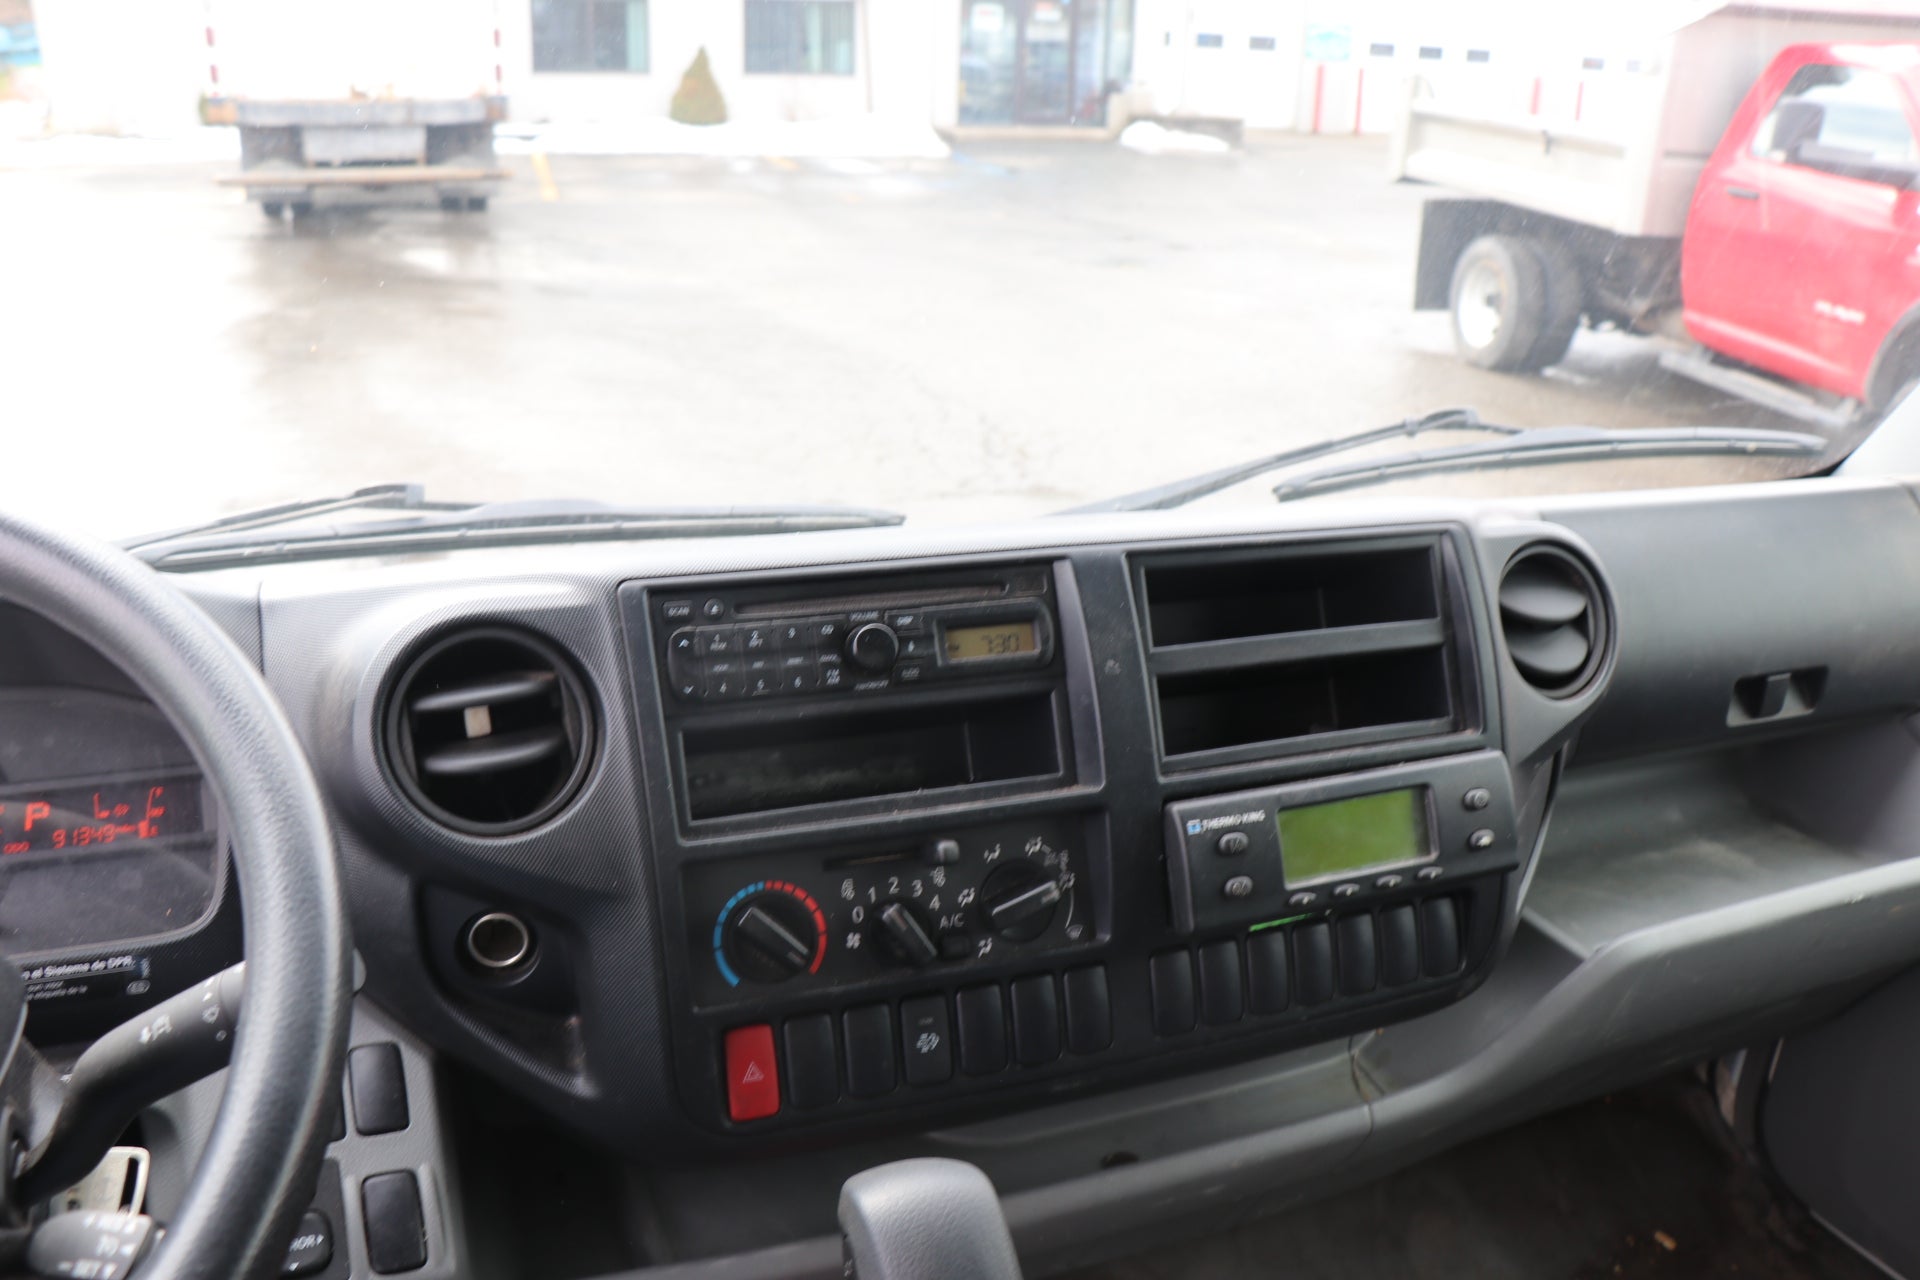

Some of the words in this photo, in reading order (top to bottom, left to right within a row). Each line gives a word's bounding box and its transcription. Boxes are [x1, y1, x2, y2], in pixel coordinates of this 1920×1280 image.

[750, 630, 759, 640] 2
[788, 627, 796, 639] 3
[719, 682, 727, 694] 4
[794, 676, 802, 688] 6
[24, 800, 51, 832] P
[1201, 814, 1241, 833] THERMO
[1242, 809, 1266, 825] KING
[888, 876, 900, 895] 2
[912, 879, 923, 898] 3
[868, 886, 876, 904] 1
[929, 894, 941, 911] 4
[852, 905, 864, 924] 0
[940, 912, 965, 930] A/C
[44, 962, 90, 977] Sistema
